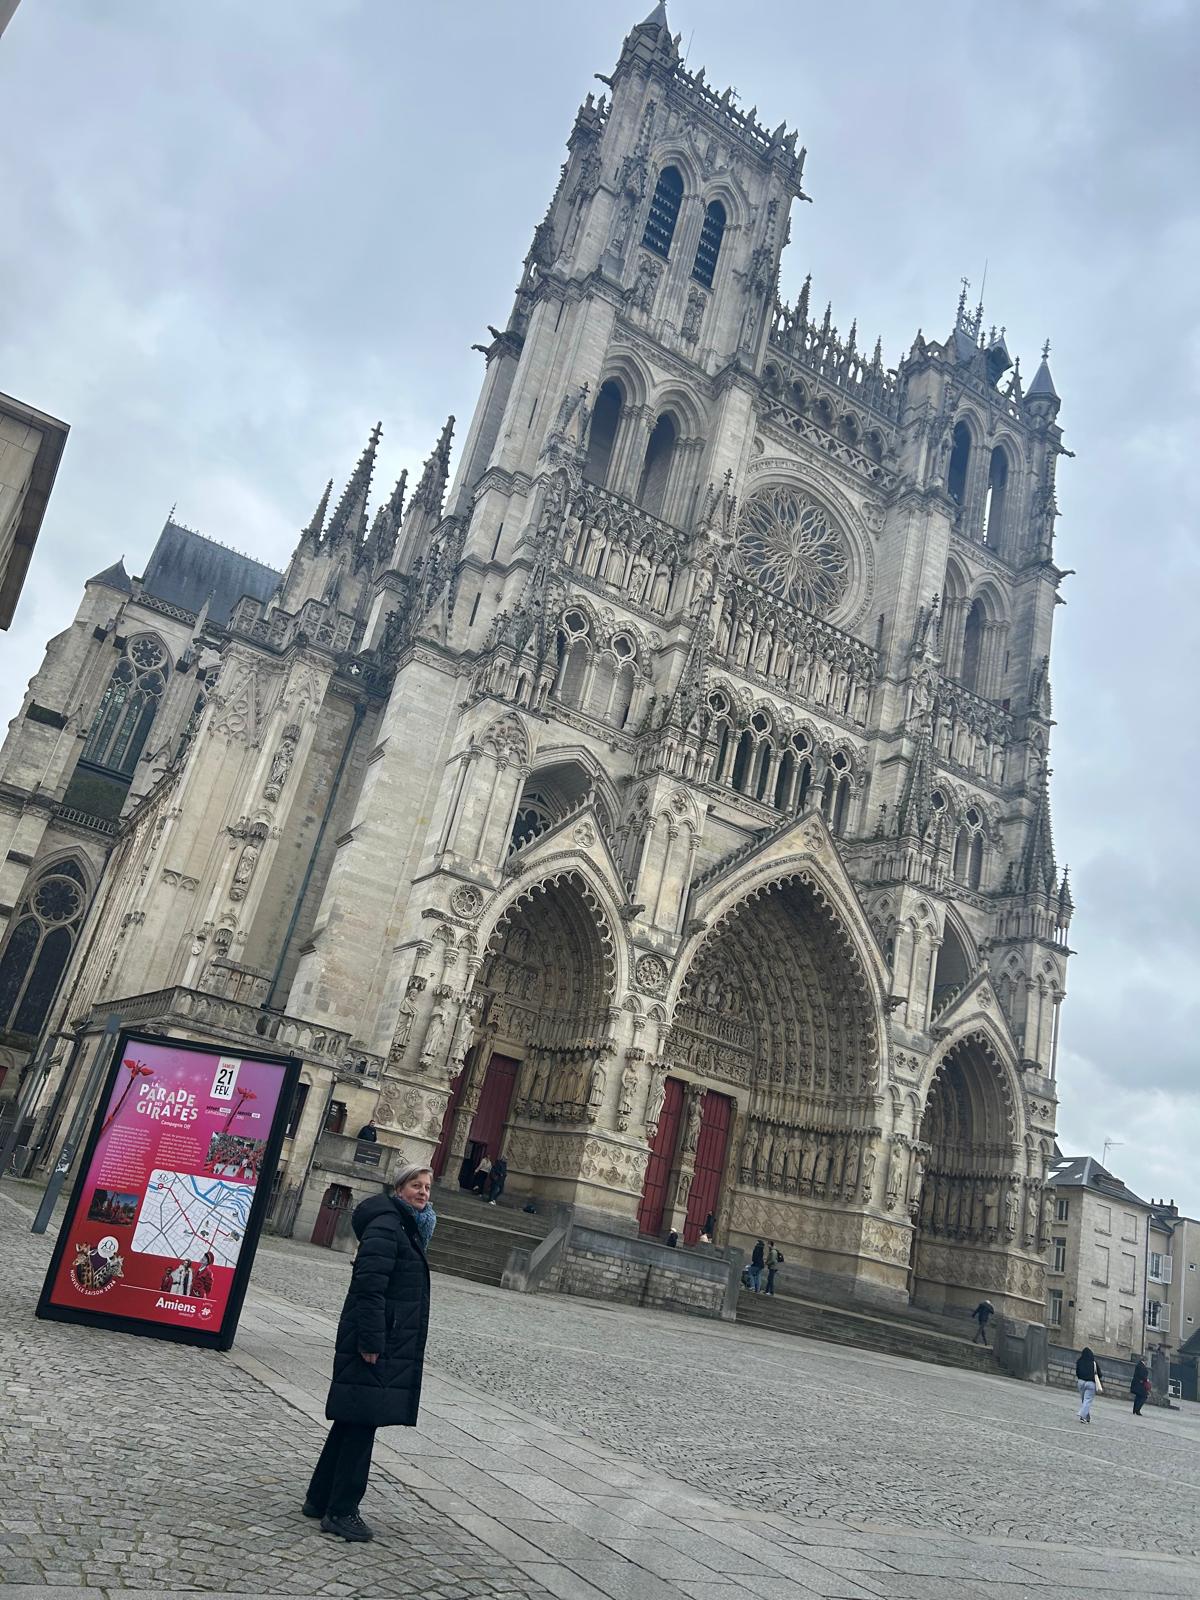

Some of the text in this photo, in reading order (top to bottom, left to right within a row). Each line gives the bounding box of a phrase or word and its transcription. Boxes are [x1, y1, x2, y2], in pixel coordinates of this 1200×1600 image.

[217, 1069, 234, 1086] 21
[139, 1083, 196, 1107] PARADE
[136, 1101, 199, 1121] GIRAFES
[160, 1120, 183, 1128] Compagnie
[70, 1269, 85, 1294] NOUVELLE
[155, 1297, 197, 1313] Amiens
